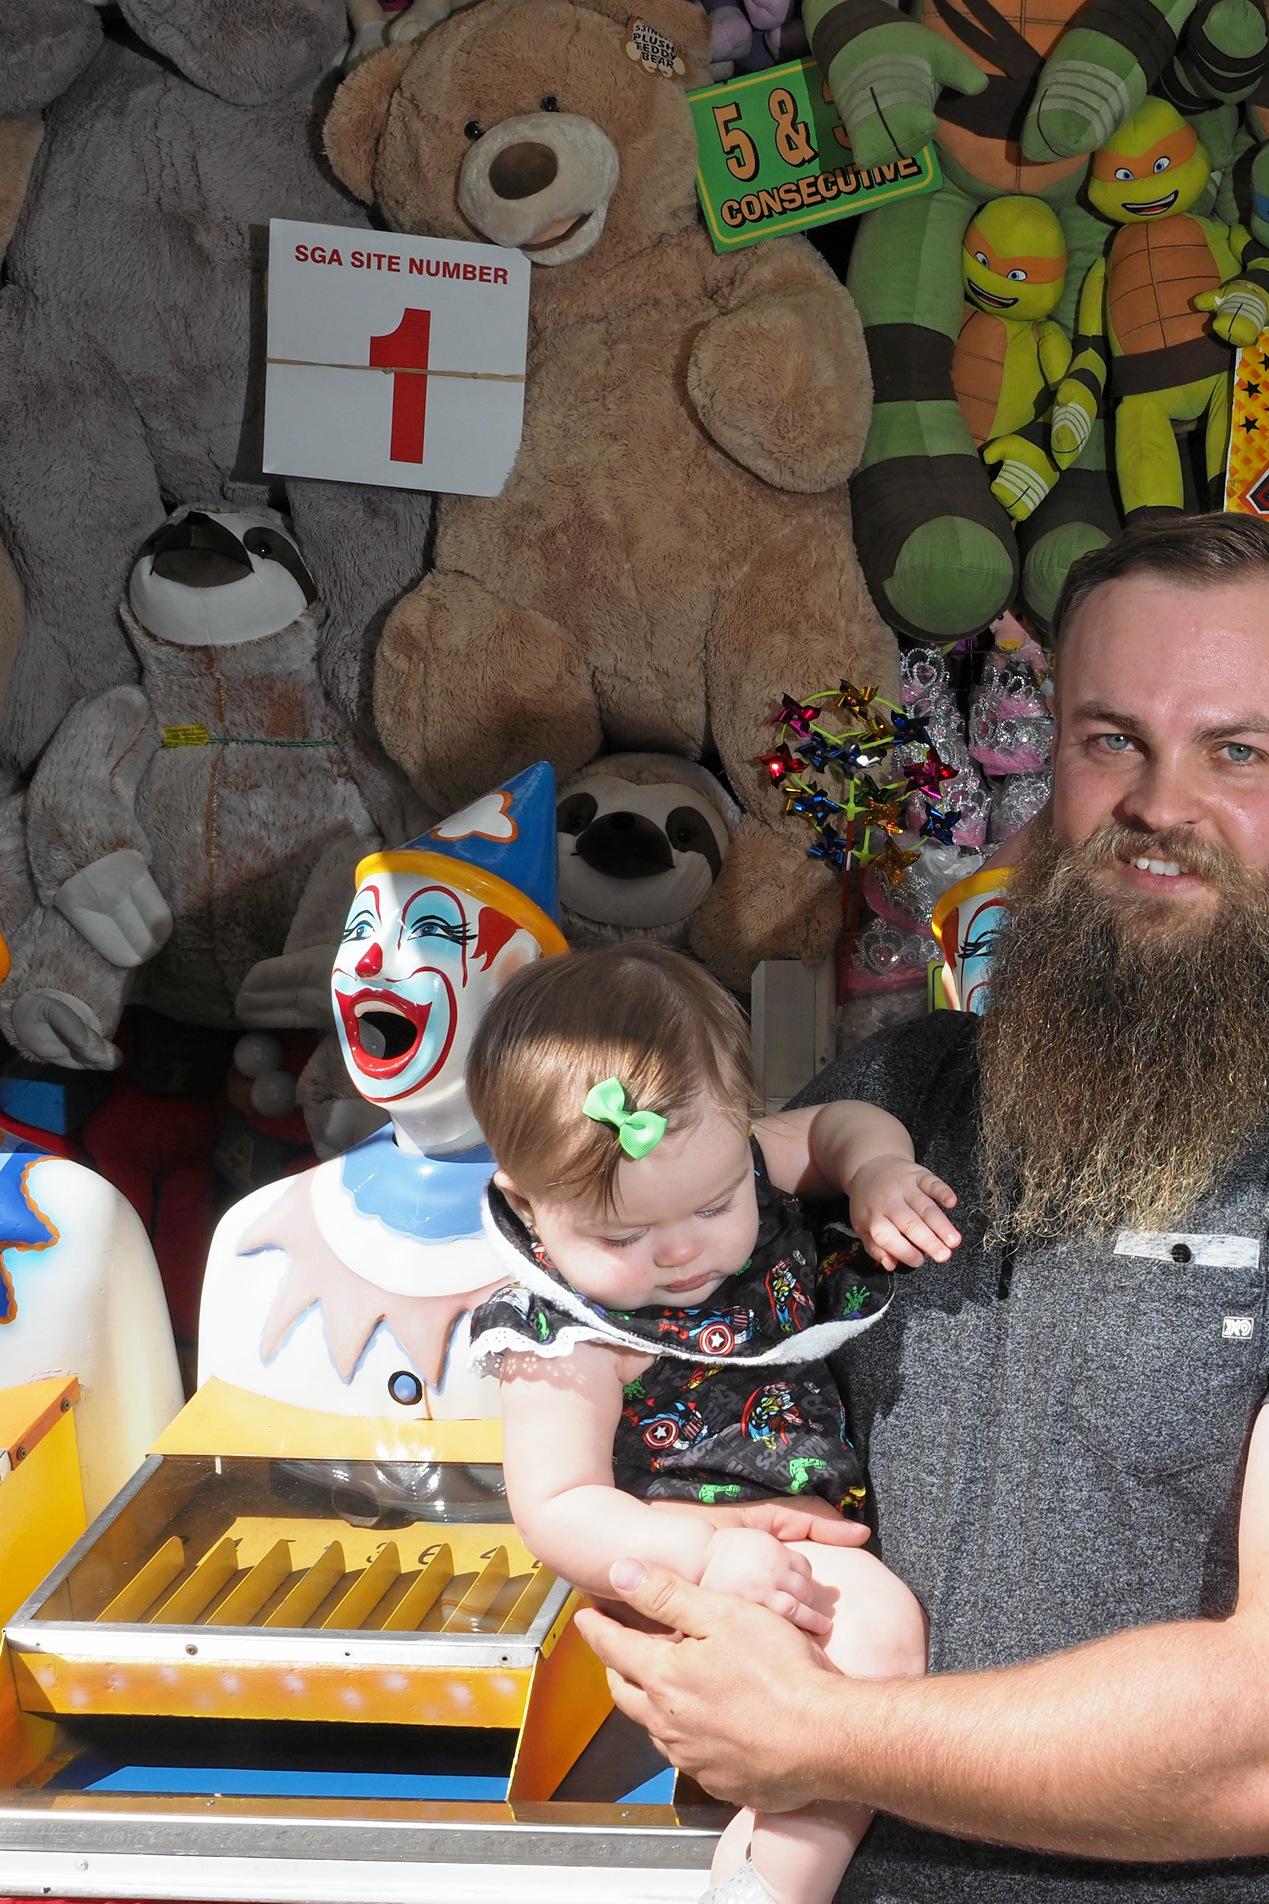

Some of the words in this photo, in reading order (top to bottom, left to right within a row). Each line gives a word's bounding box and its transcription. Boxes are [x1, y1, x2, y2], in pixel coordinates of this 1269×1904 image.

[633, 32, 675, 53] PLUSH
[634, 42, 677, 60] TEDDY
[640, 52, 674, 69] BEAR
[712, 102, 760, 183] 5
[768, 87, 819, 168] &
[294, 244, 344, 268] SGA
[350, 250, 402, 274] SITE
[408, 256, 509, 286] NUMBER
[370, 308, 432, 464] 1
